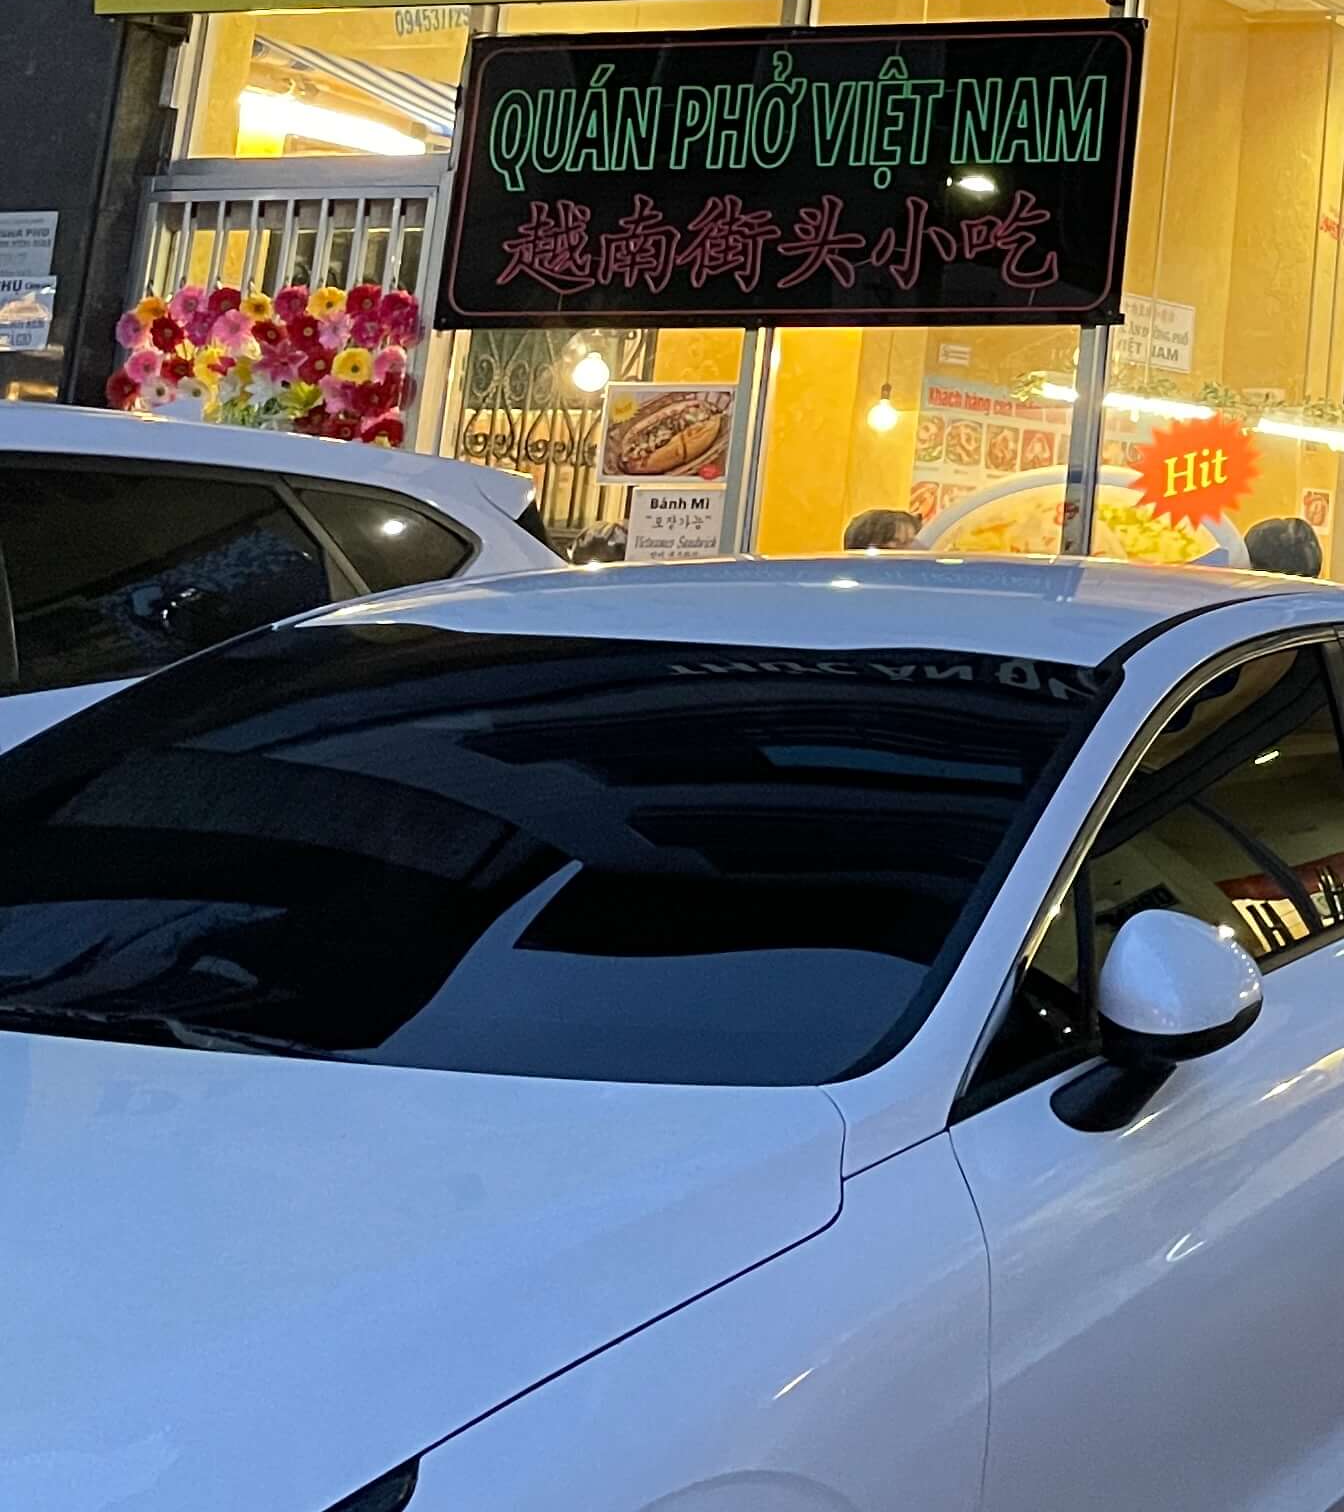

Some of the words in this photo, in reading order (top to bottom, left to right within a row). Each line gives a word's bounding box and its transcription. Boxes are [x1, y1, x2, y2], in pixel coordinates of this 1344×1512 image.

[489, 64, 661, 191] QUÁN
[670, 51, 807, 170] PHỞ
[812, 56, 945, 188] VIỆT
[950, 76, 1107, 164] NAM
[497, 190, 1059, 296] 越南街头小吃
[650, 497, 687, 510] Bánh
[1163, 446, 1229, 498] Hit
